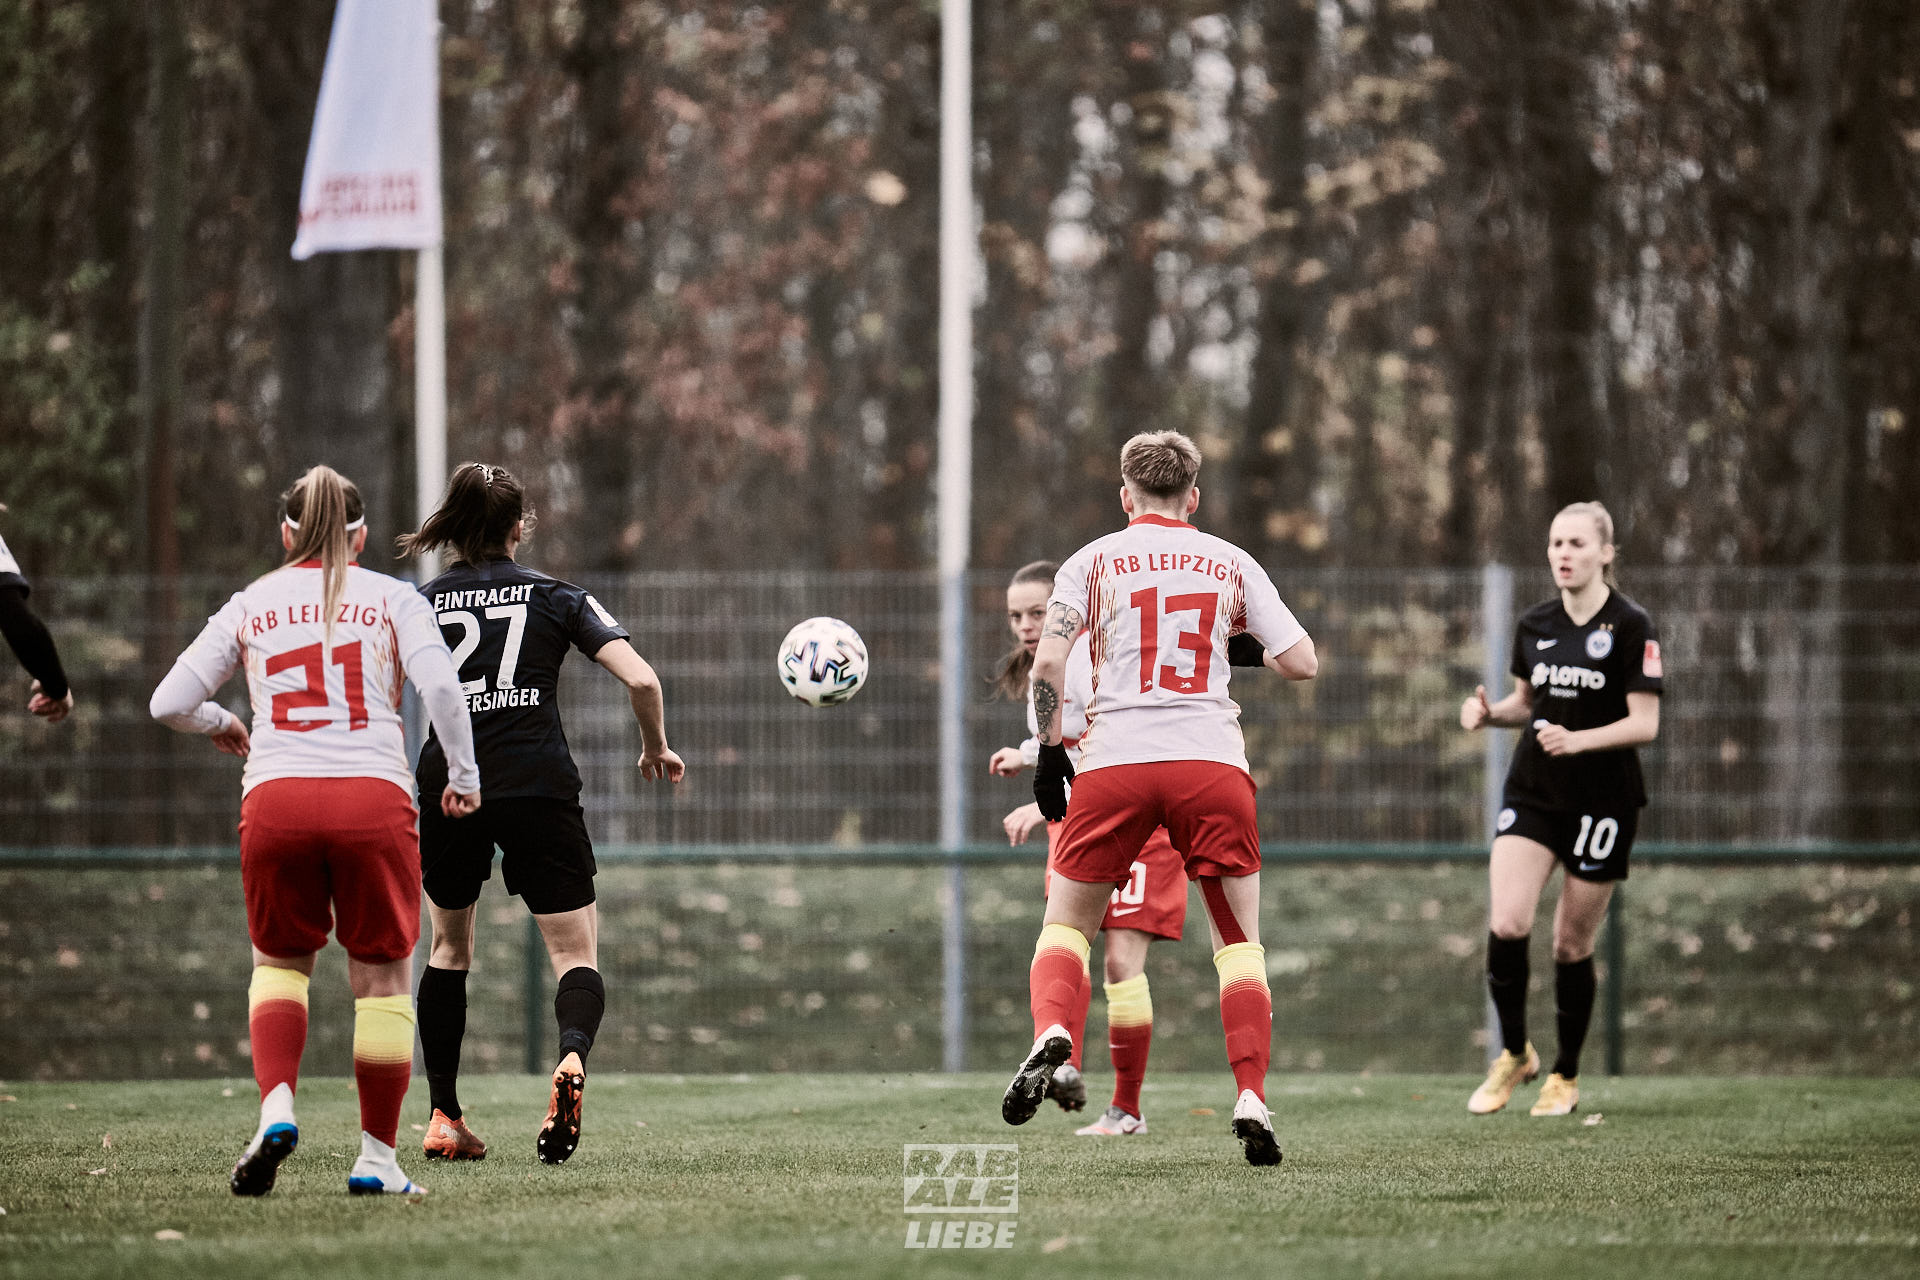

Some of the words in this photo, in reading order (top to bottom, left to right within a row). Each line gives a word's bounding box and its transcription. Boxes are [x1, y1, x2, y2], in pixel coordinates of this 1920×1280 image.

[1113, 556, 1141, 576] RB
[1148, 553, 1228, 581] LEIPZIG
[434, 584, 535, 613] EINTRACHT
[251, 610, 278, 637] RB
[288, 604, 377, 627] LEIZIG
[1130, 586, 1219, 694] 13
[438, 603, 528, 696] 27
[265, 639, 369, 732] 21
[1549, 664, 1606, 690] LOTTO
[1573, 815, 1619, 860] 10
